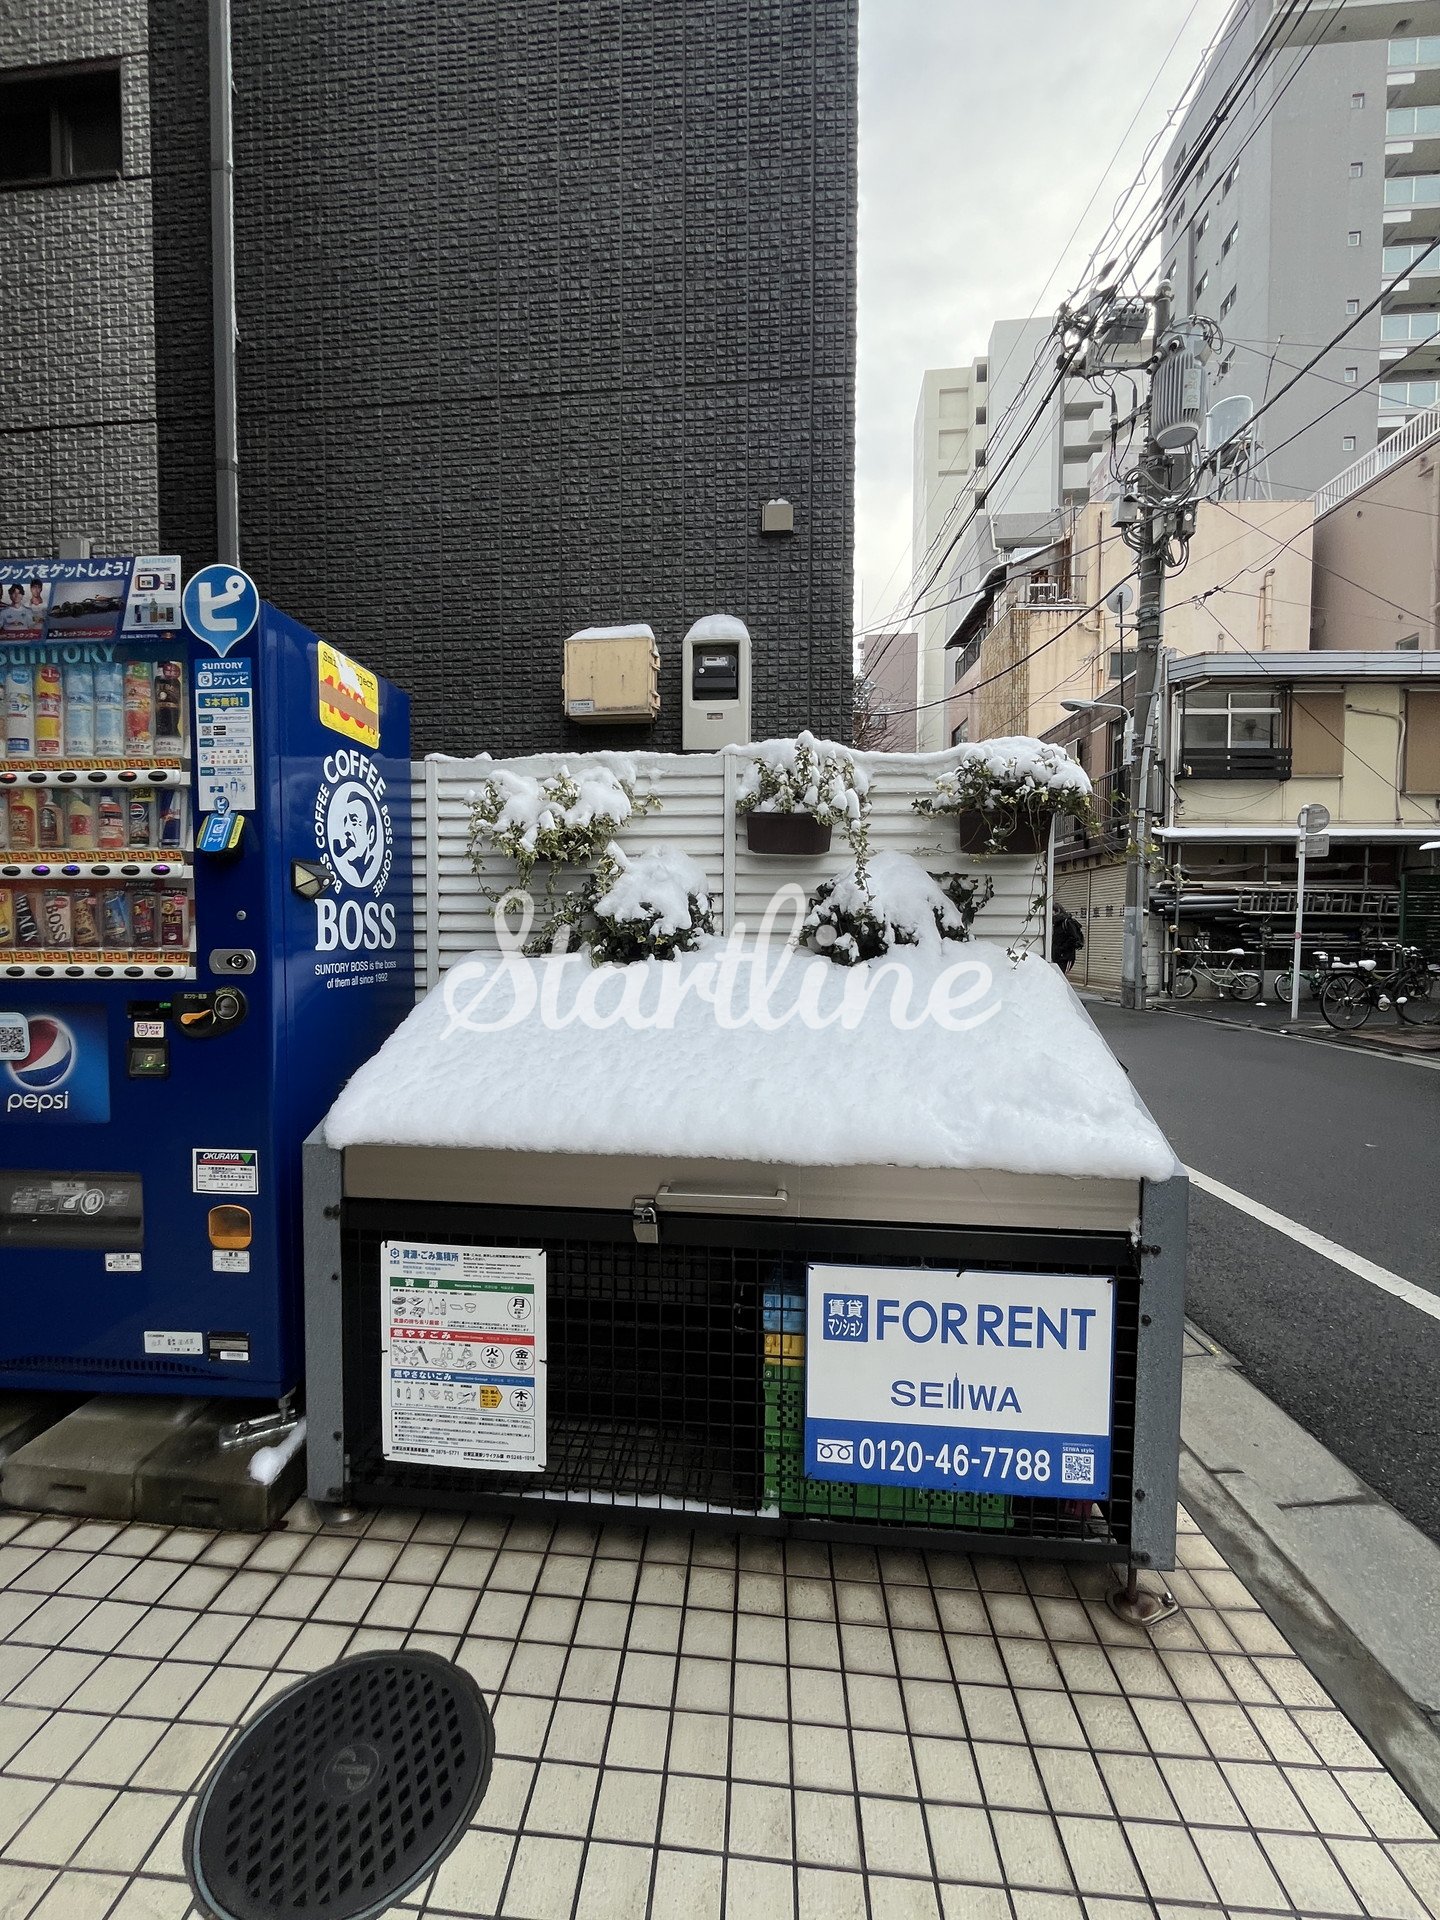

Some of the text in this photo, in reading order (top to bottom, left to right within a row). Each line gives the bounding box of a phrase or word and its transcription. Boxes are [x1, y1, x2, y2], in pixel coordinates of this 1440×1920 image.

[198, 575, 246, 632] ピ
[202, 662, 244, 670] SUNTORY
[213, 676, 249, 686] ジハンピ
[323, 749, 387, 801] COFFEE
[314, 783, 330, 849] COFFEE
[372, 804, 393, 898] BOSS COFFEE
[15, 893, 39, 943] BLACK
[45, 898, 68, 944] BOSS
[314, 898, 397, 951] BOSS
[314, 959, 397, 976] SUNTORY BOSS is the boss
[326, 972, 388, 989] of them all since 1992
[7, 1090, 69, 1113] pepsi
[202, 1152, 240, 1160] OKURAYA
[513, 1298, 525, 1309] 月
[828, 1298, 864, 1319] 賃貸
[393, 1328, 451, 1340] 燃やすごみ
[827, 1318, 864, 1338] マンション
[486, 1347, 499, 1358] 火
[515, 1348, 529, 1360] 金
[393, 1369, 452, 1381] 燃やさないごみ
[514, 1390, 528, 1401] 木
[858, 1438, 1051, 1483] 0120-46-7788
